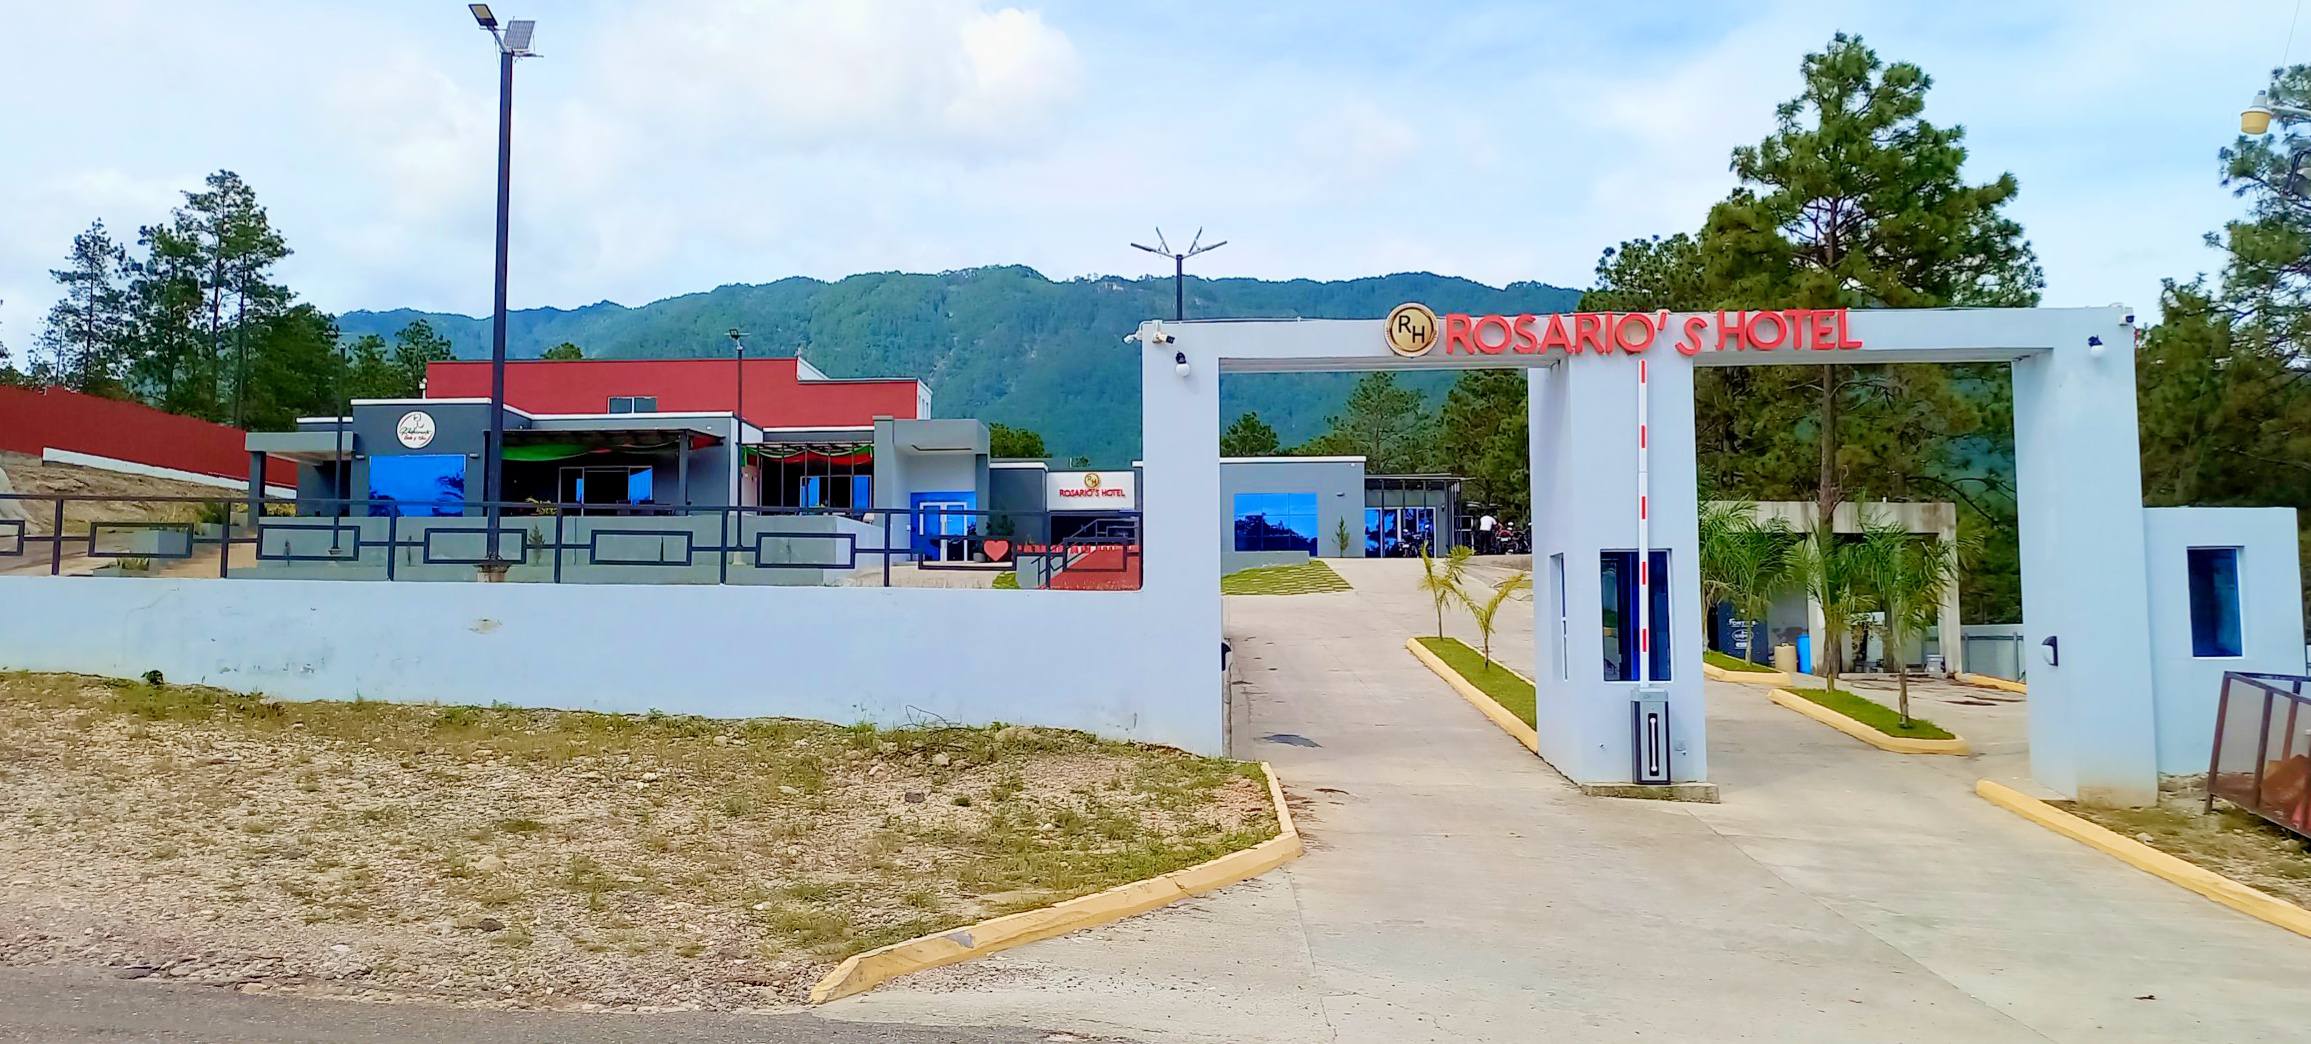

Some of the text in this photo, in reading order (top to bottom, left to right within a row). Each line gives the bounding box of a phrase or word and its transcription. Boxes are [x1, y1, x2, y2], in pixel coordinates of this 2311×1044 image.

[1398, 315, 1425, 343] RH
[1715, 308, 1863, 351] HOTEL
[1101, 489, 1125, 497] HOTEL
